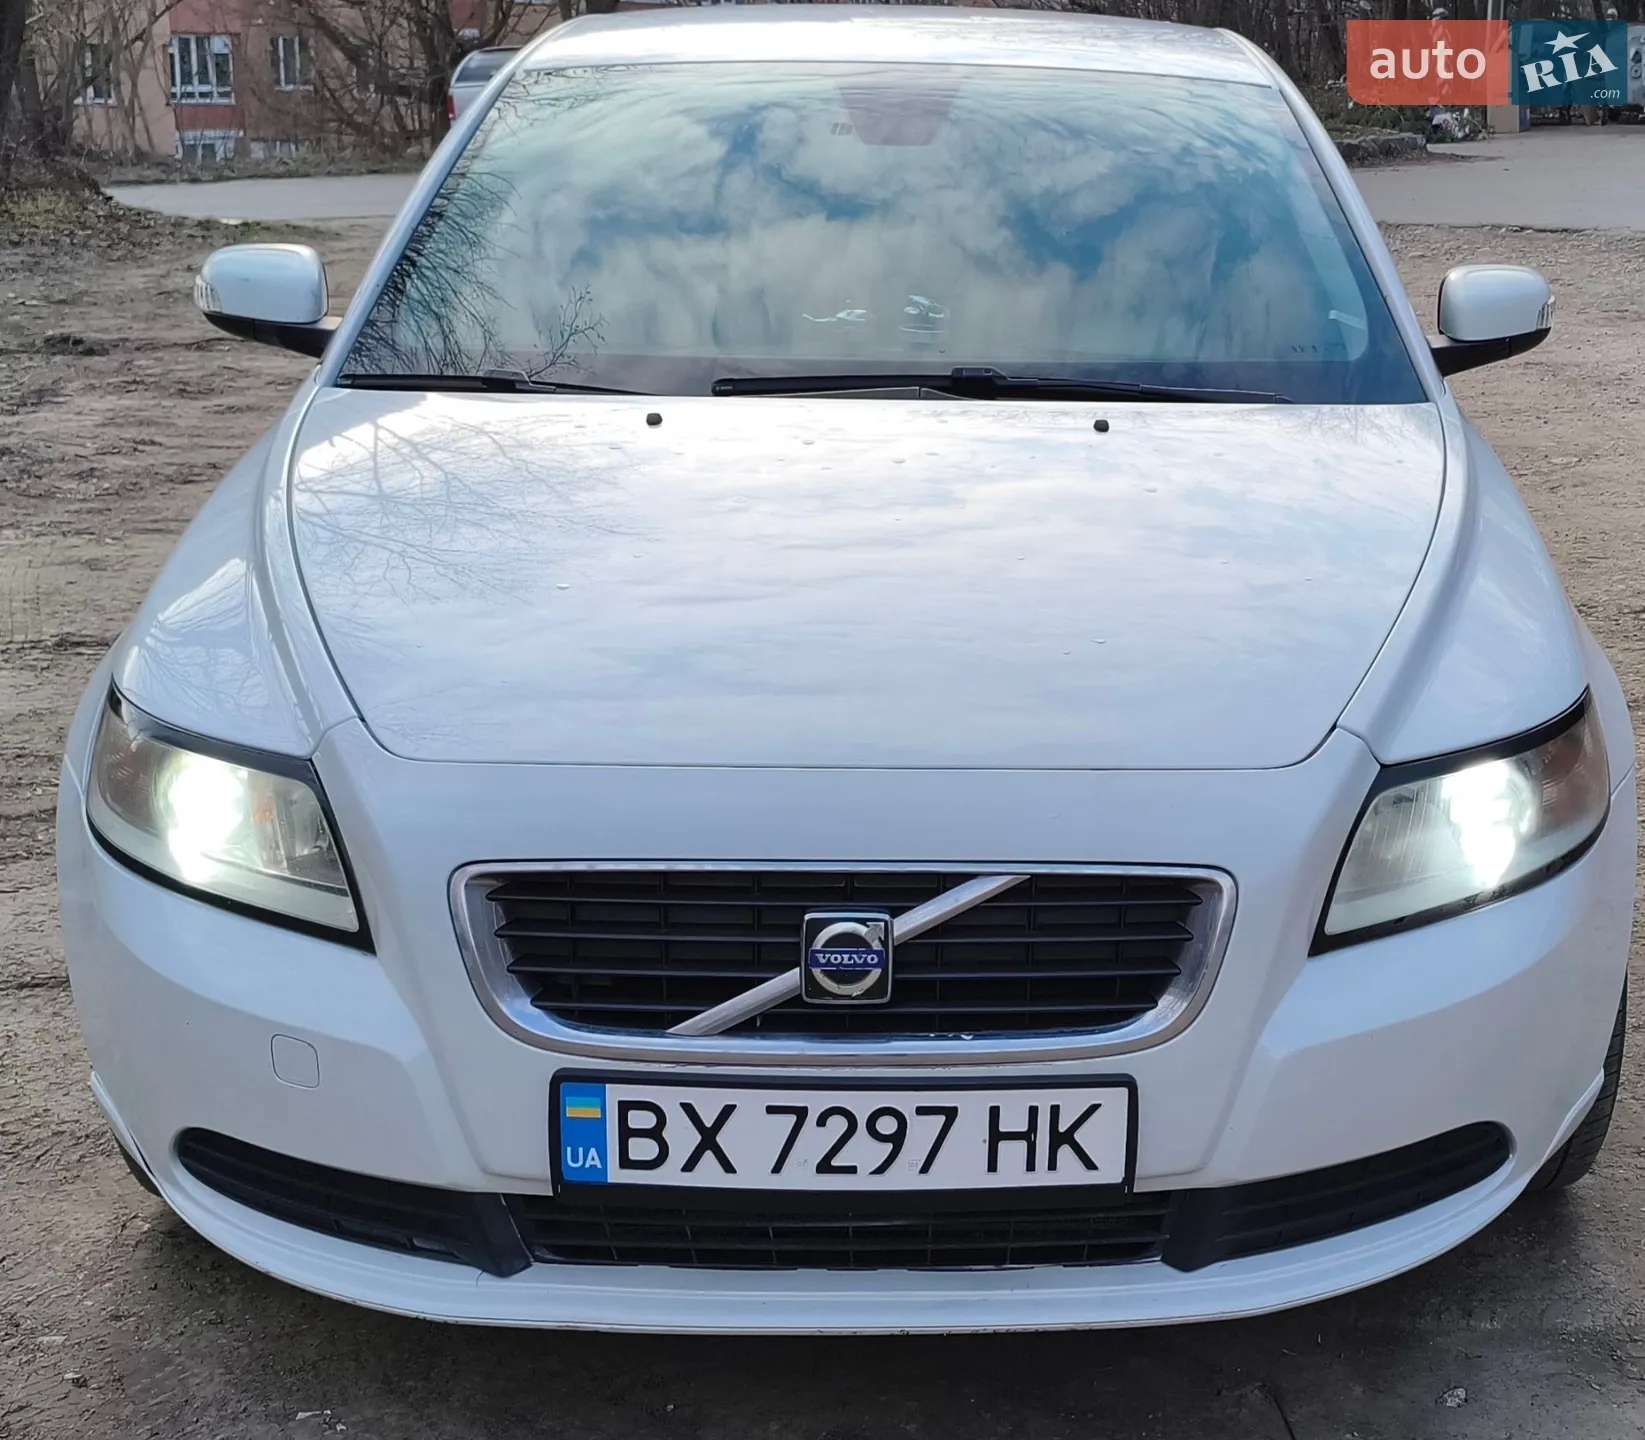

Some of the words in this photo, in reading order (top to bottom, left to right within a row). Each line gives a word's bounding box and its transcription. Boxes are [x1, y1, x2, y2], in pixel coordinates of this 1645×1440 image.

[814, 953, 879, 965] VOLVO
[617, 1099, 738, 1175] BX
[764, 1104, 959, 1176] 7297
[986, 1103, 1103, 1173] HK
[566, 1146, 603, 1169] UA
